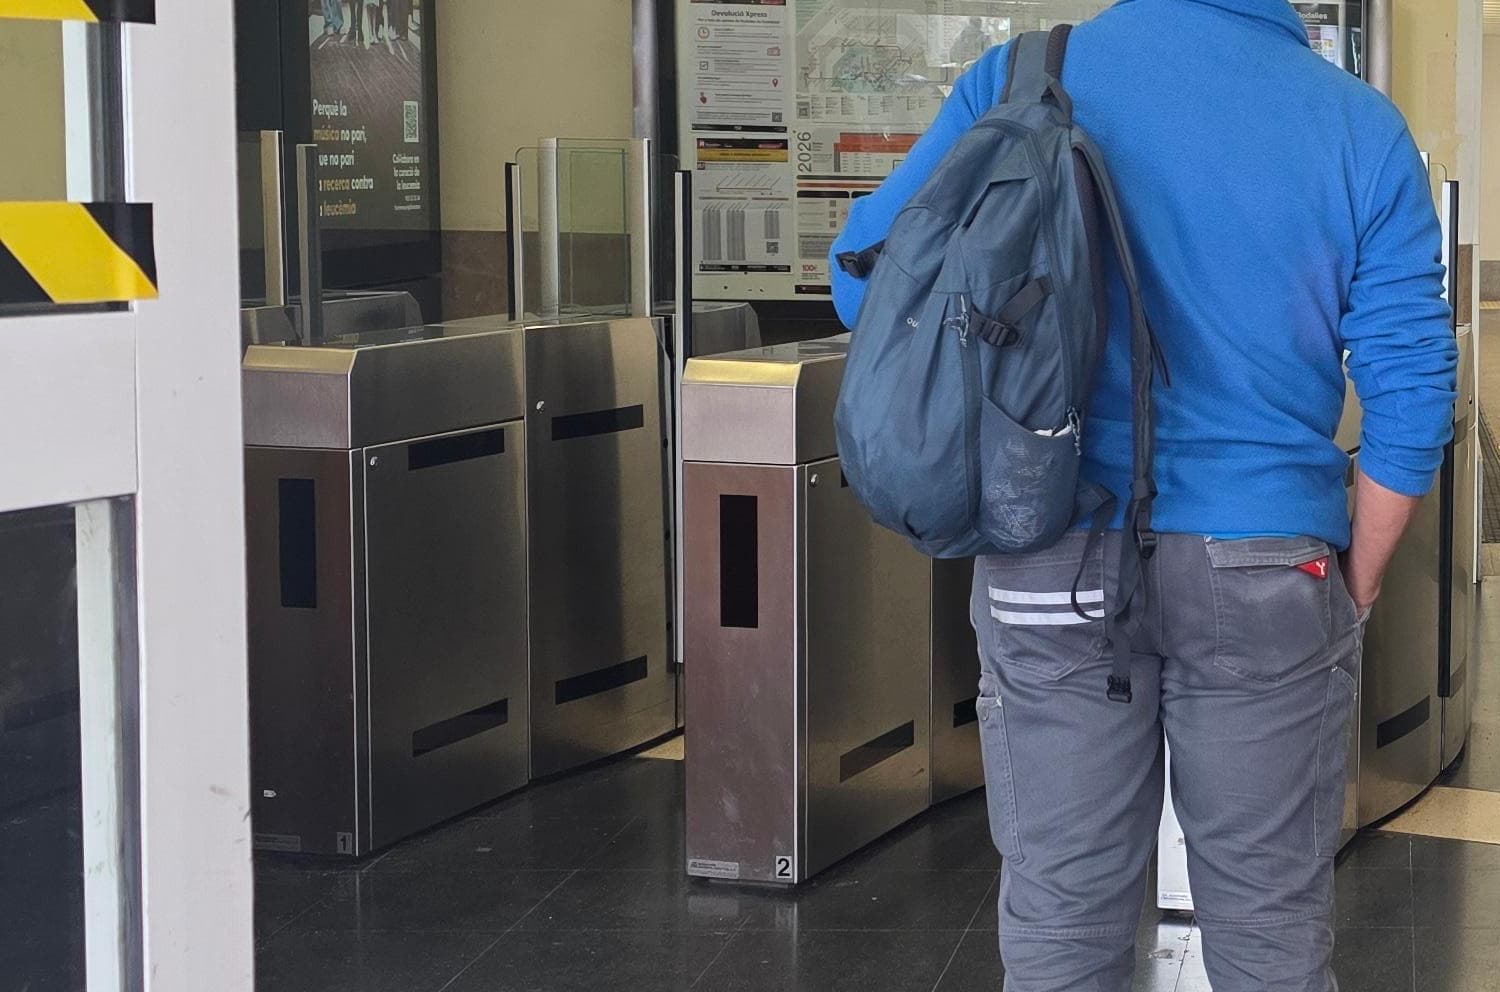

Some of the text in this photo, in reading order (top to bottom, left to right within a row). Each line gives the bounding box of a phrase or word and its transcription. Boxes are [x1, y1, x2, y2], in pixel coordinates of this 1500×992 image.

[340, 100, 347, 116] la
[340, 129, 350, 140] no
[319, 150, 355, 169] ue no pari
[798, 131, 812, 173] 2026
[351, 175, 374, 190] contra
[340, 834, 347, 851] 1
[777, 858, 790, 876] 2
